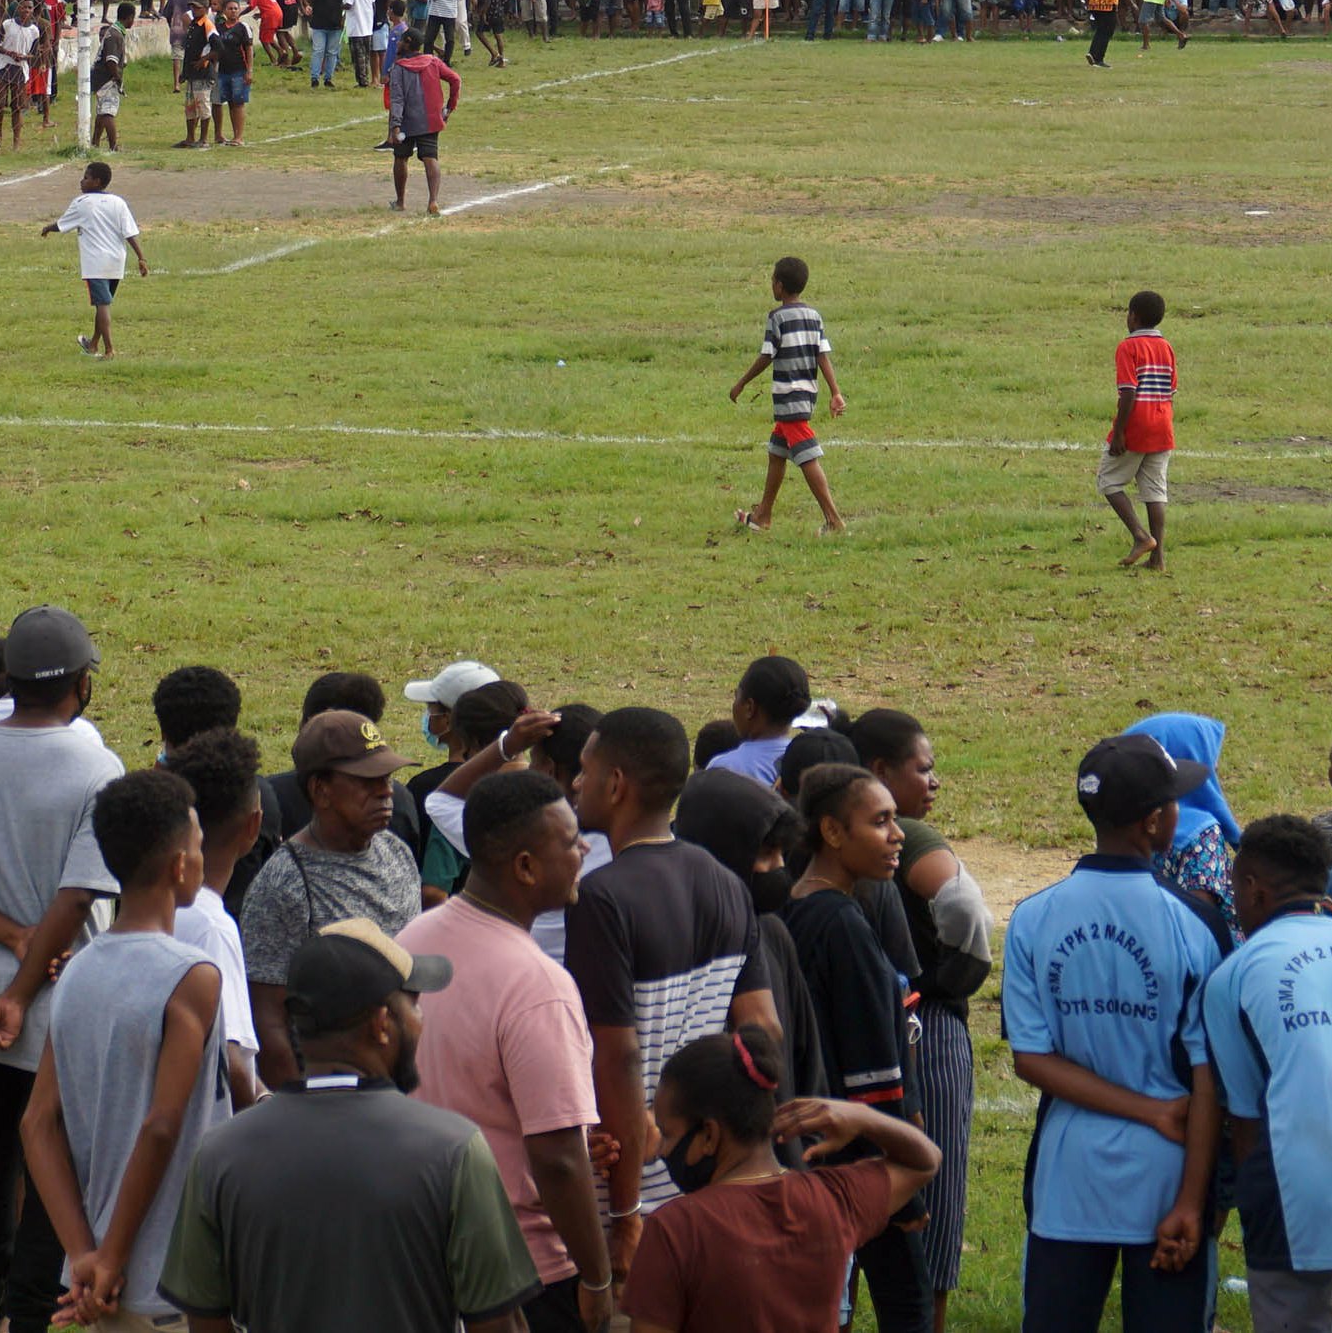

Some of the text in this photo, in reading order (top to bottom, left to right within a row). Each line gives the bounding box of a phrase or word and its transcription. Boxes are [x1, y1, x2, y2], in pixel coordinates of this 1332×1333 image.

[1048, 922, 1159, 1001] SMA YPK 2 MARANATA
[1284, 950, 1315, 975] YPK
[1315, 947, 1327, 960] 2
[1278, 979, 1295, 1013] SMA
[1282, 1011, 1332, 1033] KOTA
